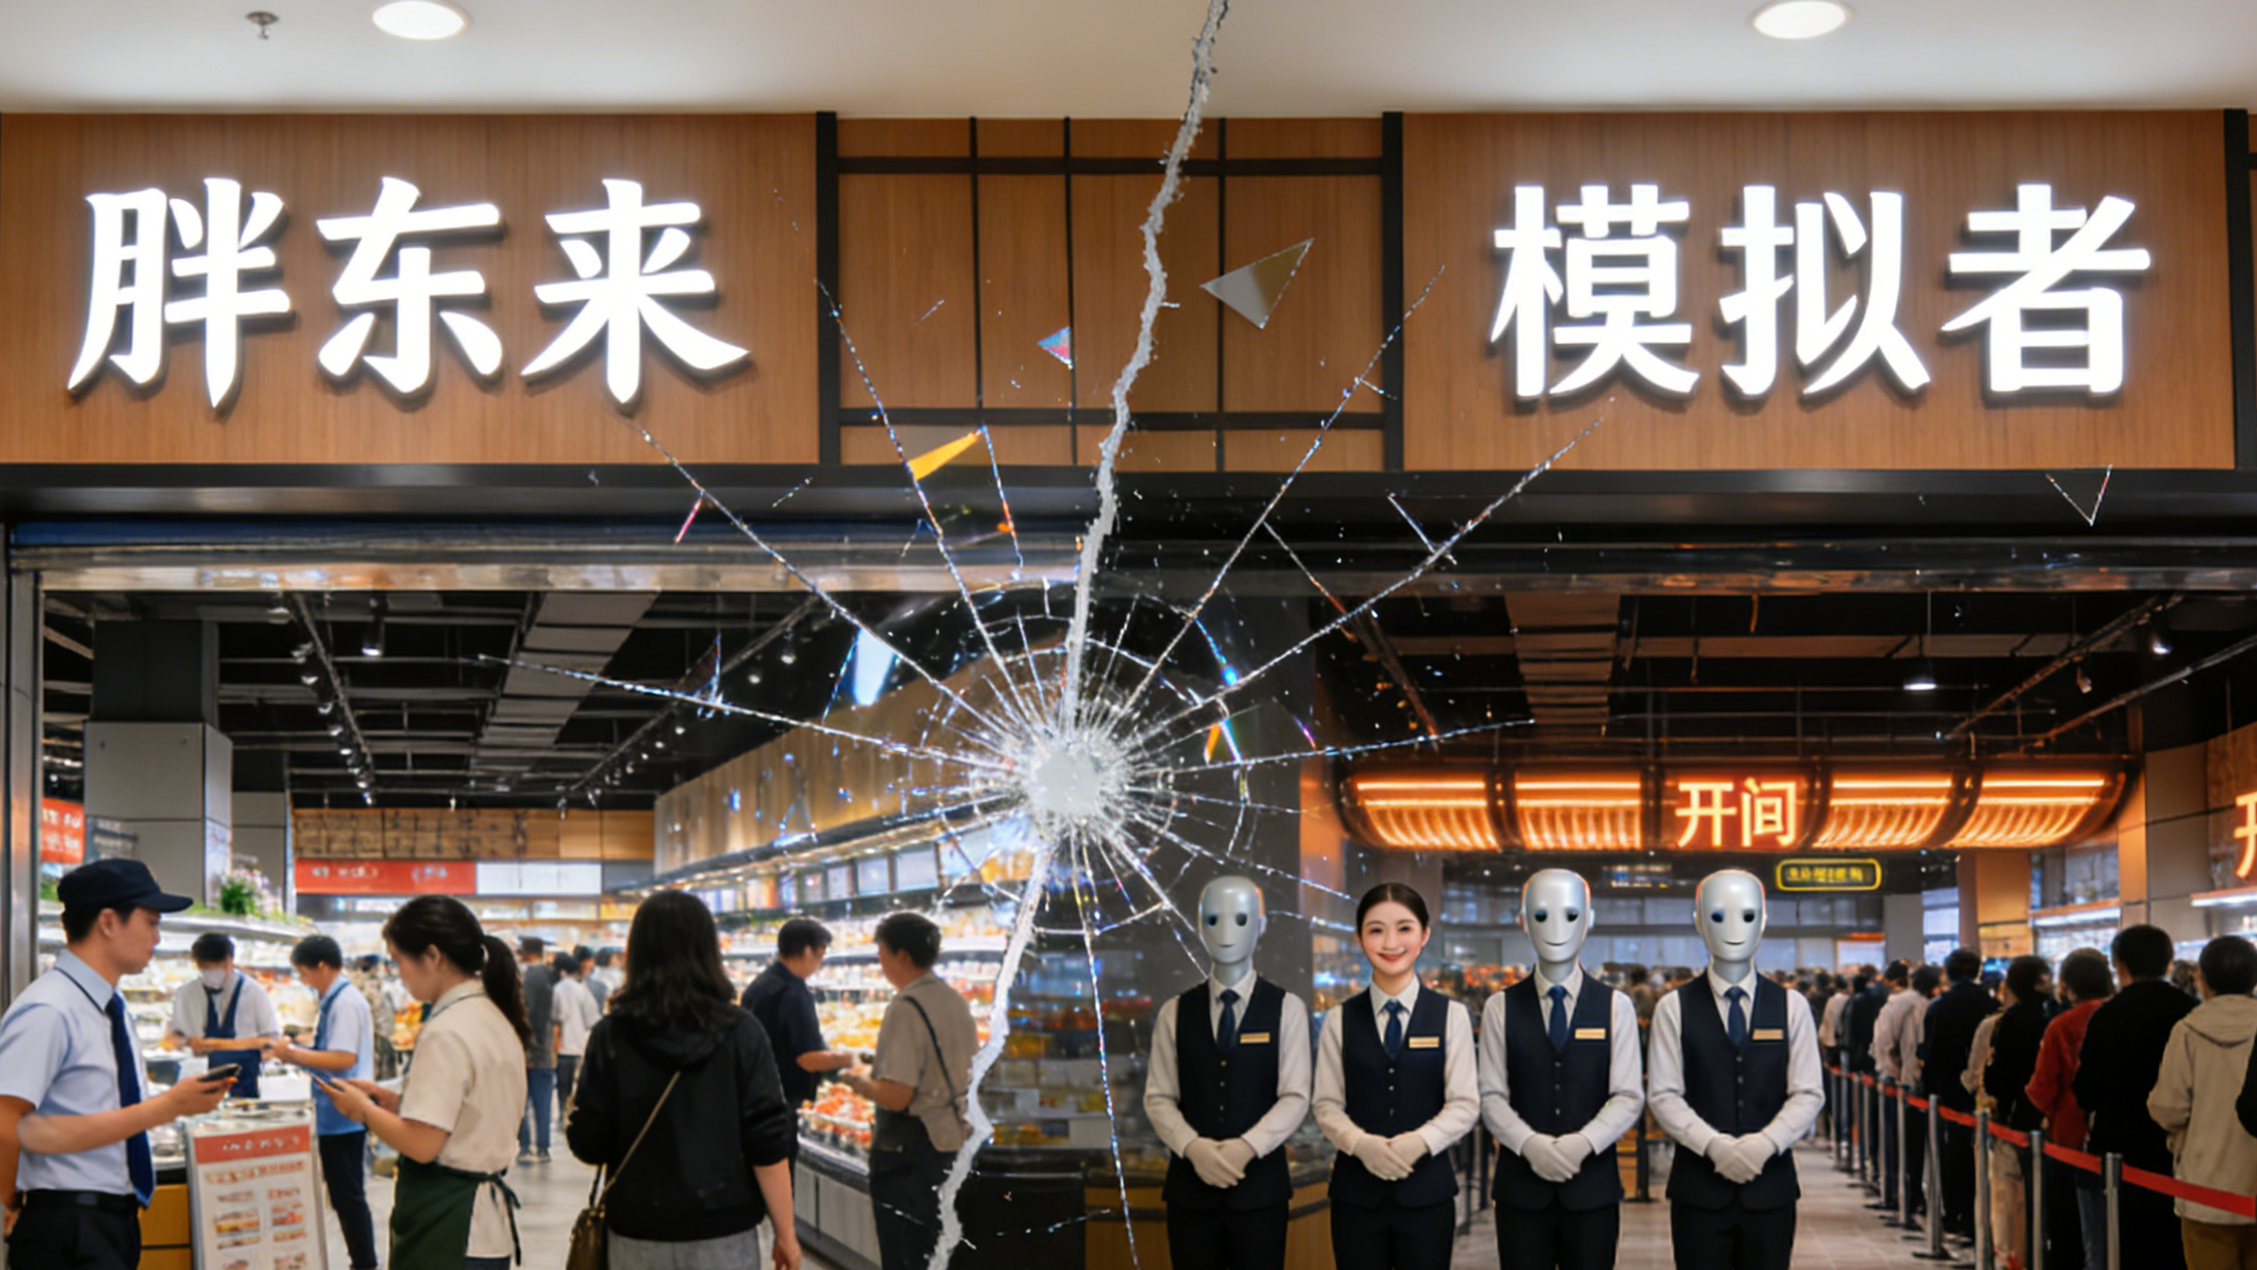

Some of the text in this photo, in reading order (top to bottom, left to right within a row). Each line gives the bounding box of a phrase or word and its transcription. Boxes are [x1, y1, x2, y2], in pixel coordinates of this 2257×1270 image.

[68, 177, 749, 408] 胖东来
[1490, 184, 2151, 397] 模拟者
[1675, 777, 1797, 848] 开间
